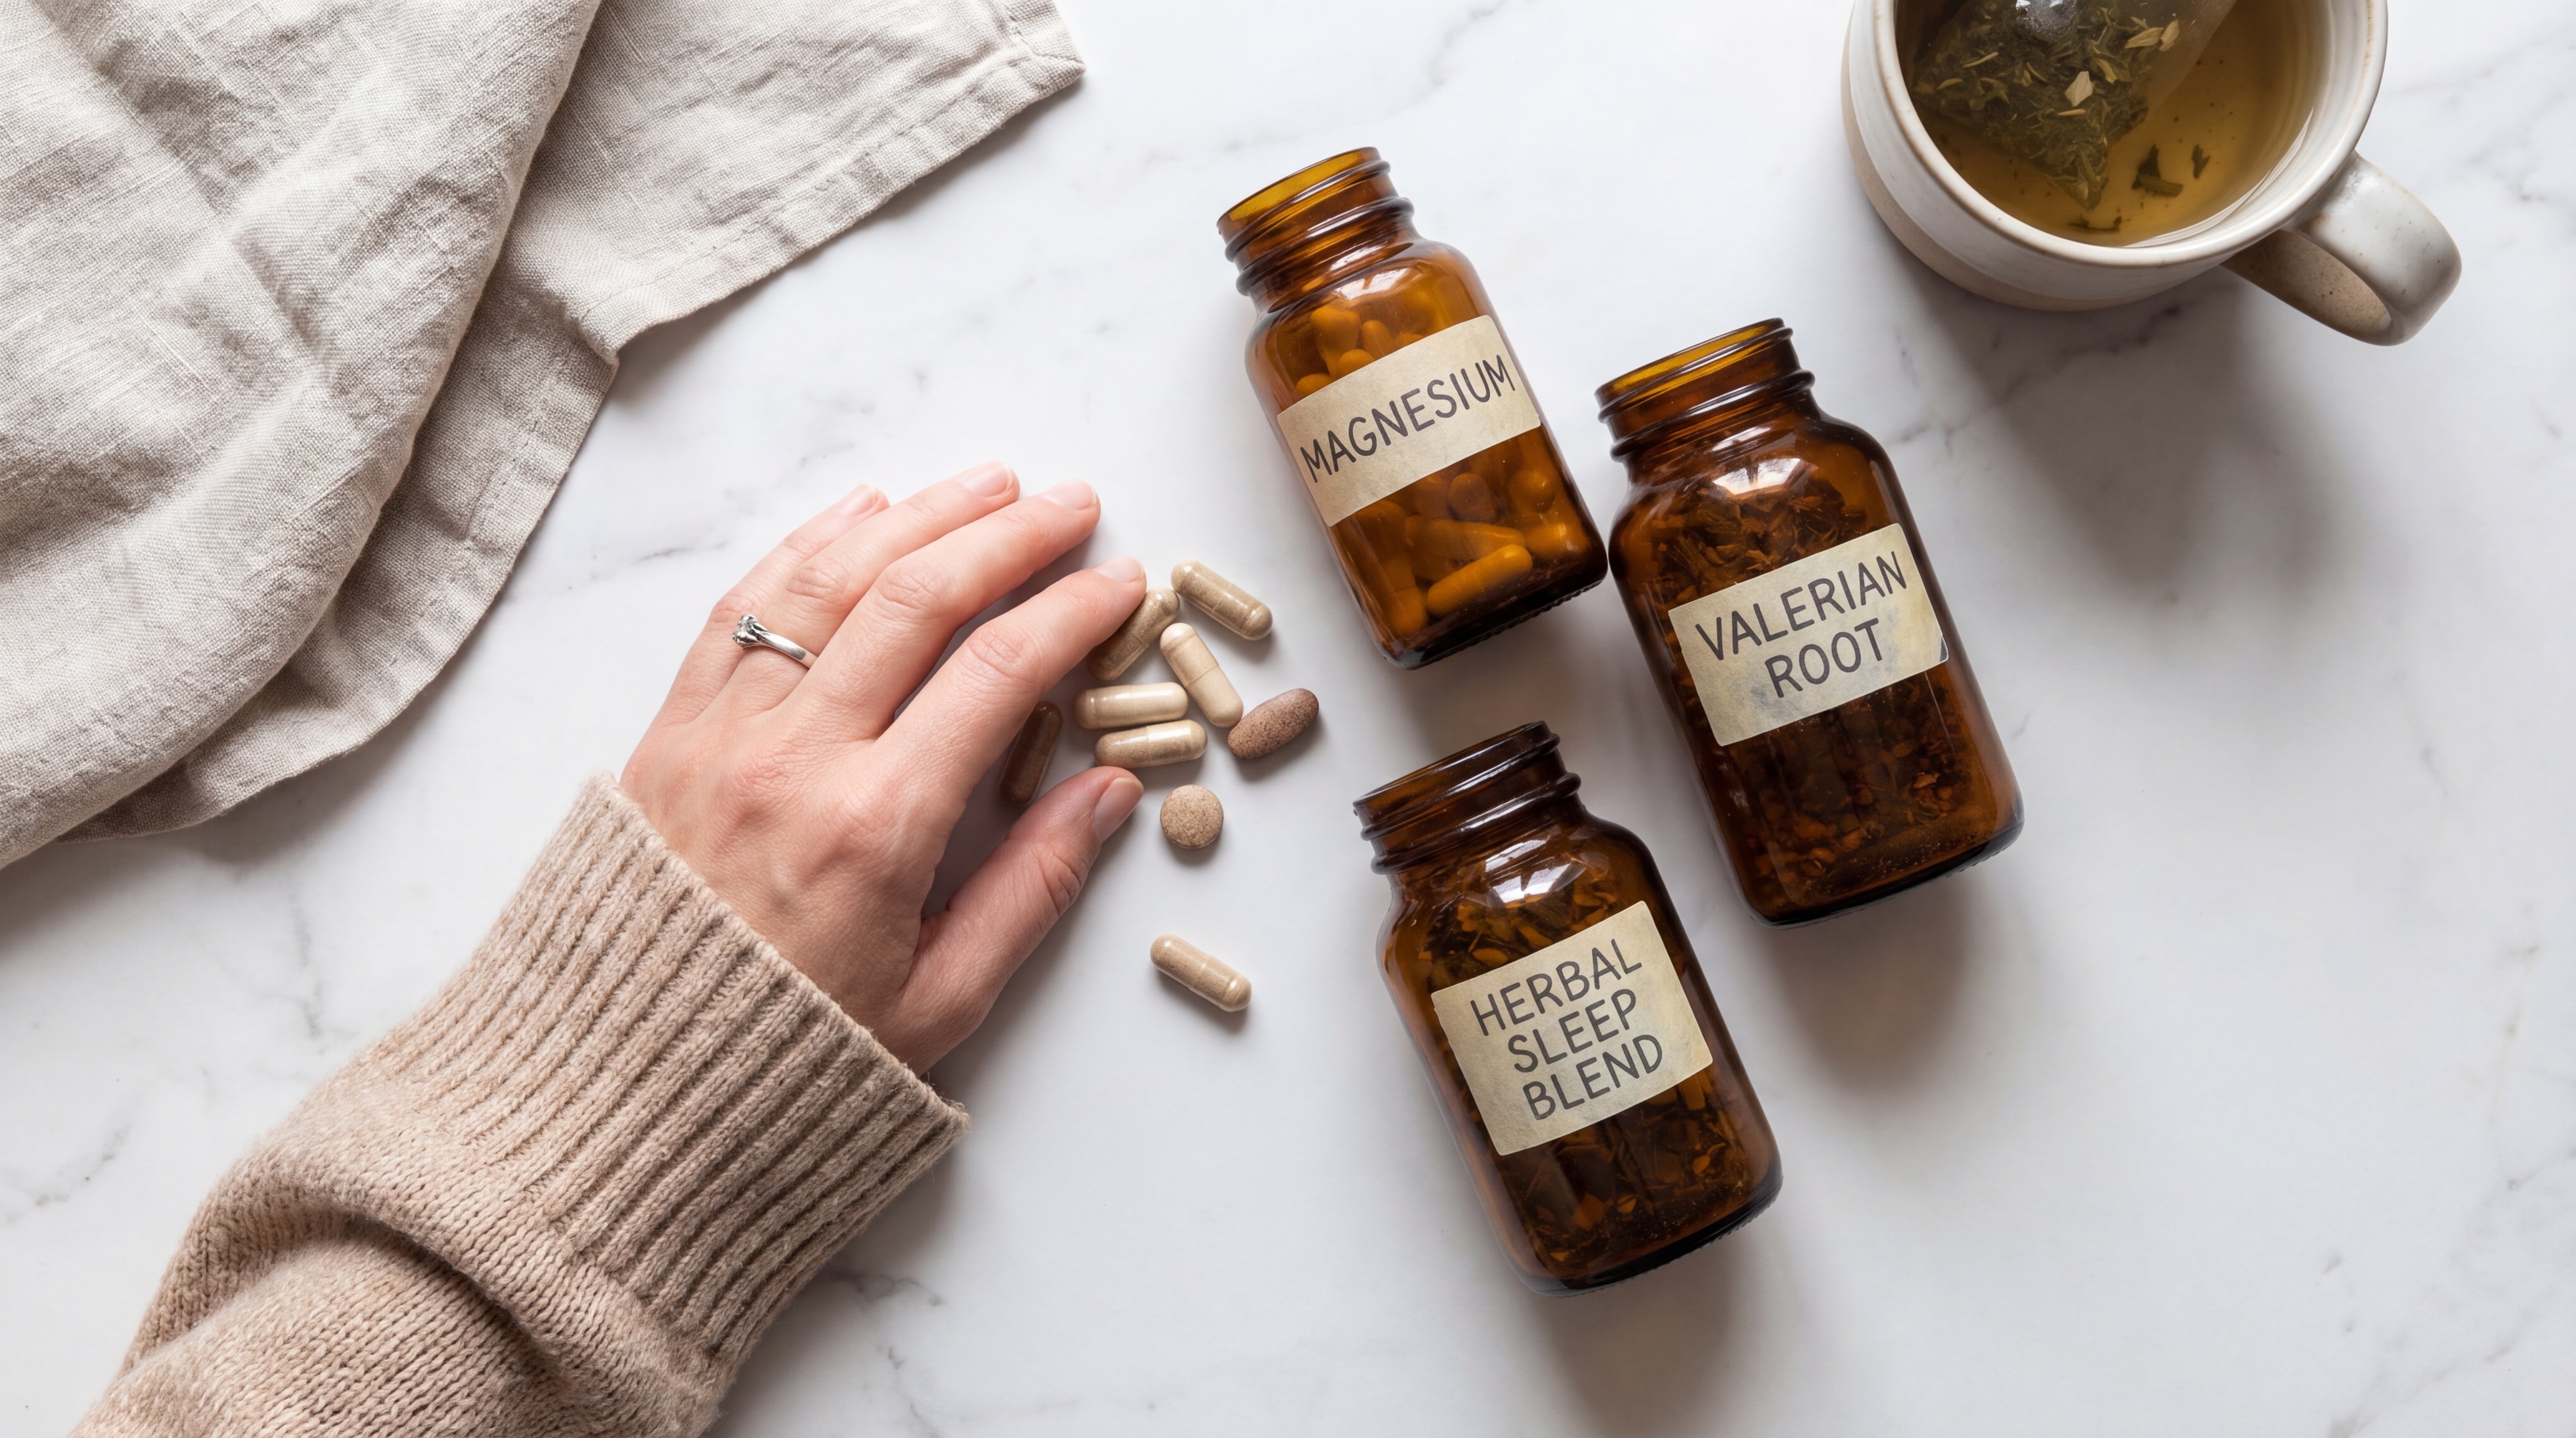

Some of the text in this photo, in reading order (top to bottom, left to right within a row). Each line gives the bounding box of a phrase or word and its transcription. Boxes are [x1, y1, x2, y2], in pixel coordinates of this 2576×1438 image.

[1300, 354, 1516, 484] MAGNESIUM
[1695, 550, 1907, 660] VALERIAN
[1764, 617, 1882, 698] ROOT
[1470, 938, 1642, 1036] HERBAL
[1508, 989, 1637, 1073] SLEEP
[1522, 1034, 1663, 1121] BLEND
